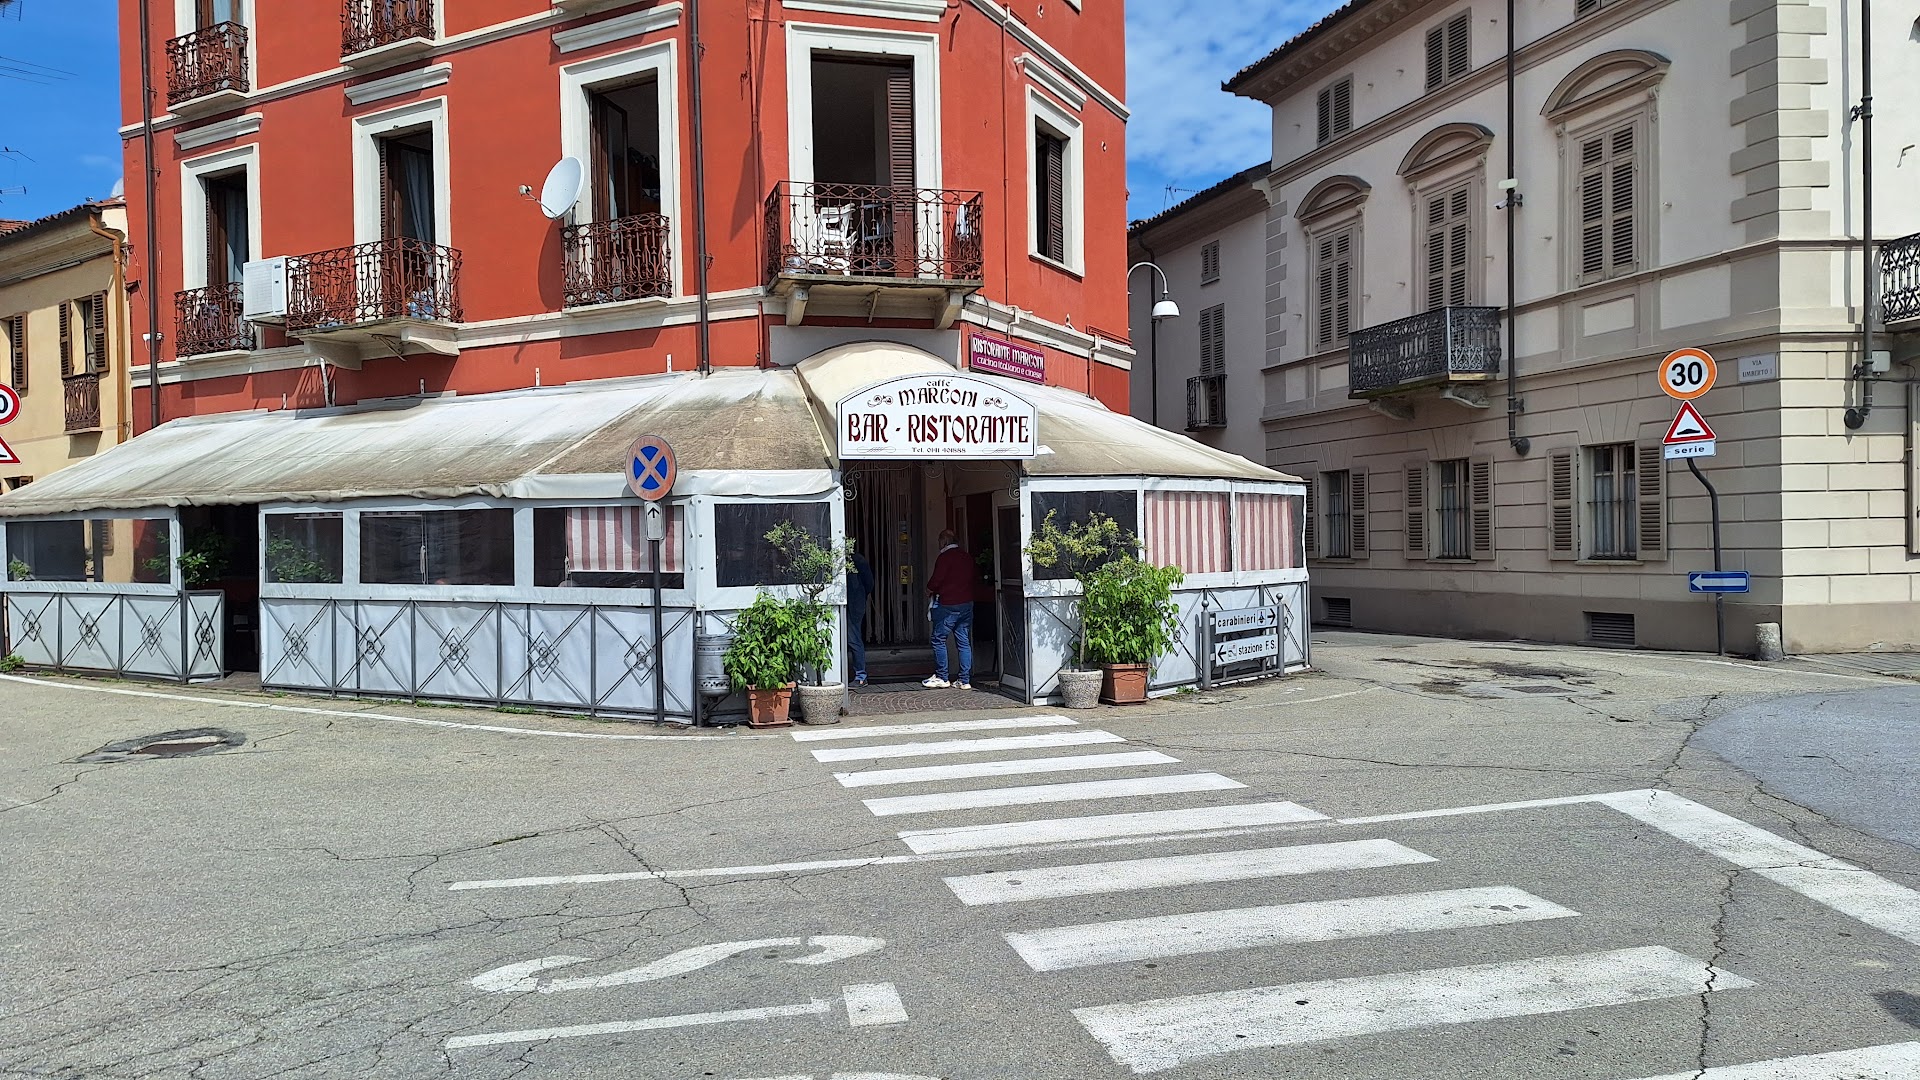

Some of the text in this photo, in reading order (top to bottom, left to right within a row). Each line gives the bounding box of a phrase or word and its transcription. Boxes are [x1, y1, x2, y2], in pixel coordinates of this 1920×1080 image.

[972, 337, 1044, 370] RISTORANTE MARCONI
[1020, 367, 1025, 376] e
[1024, 369, 1043, 380] cinese
[1671, 361, 1702, 386] 30
[1742, 369, 1768, 377] UMBERTO
[898, 387, 978, 408] MARCONI
[848, 413, 889, 443] BAR
[908, 414, 1029, 444] RISTORANTE
[1674, 446, 1705, 455] serie
[1217, 613, 1256, 628] carabinieri
[1238, 643, 1263, 656] stazione
